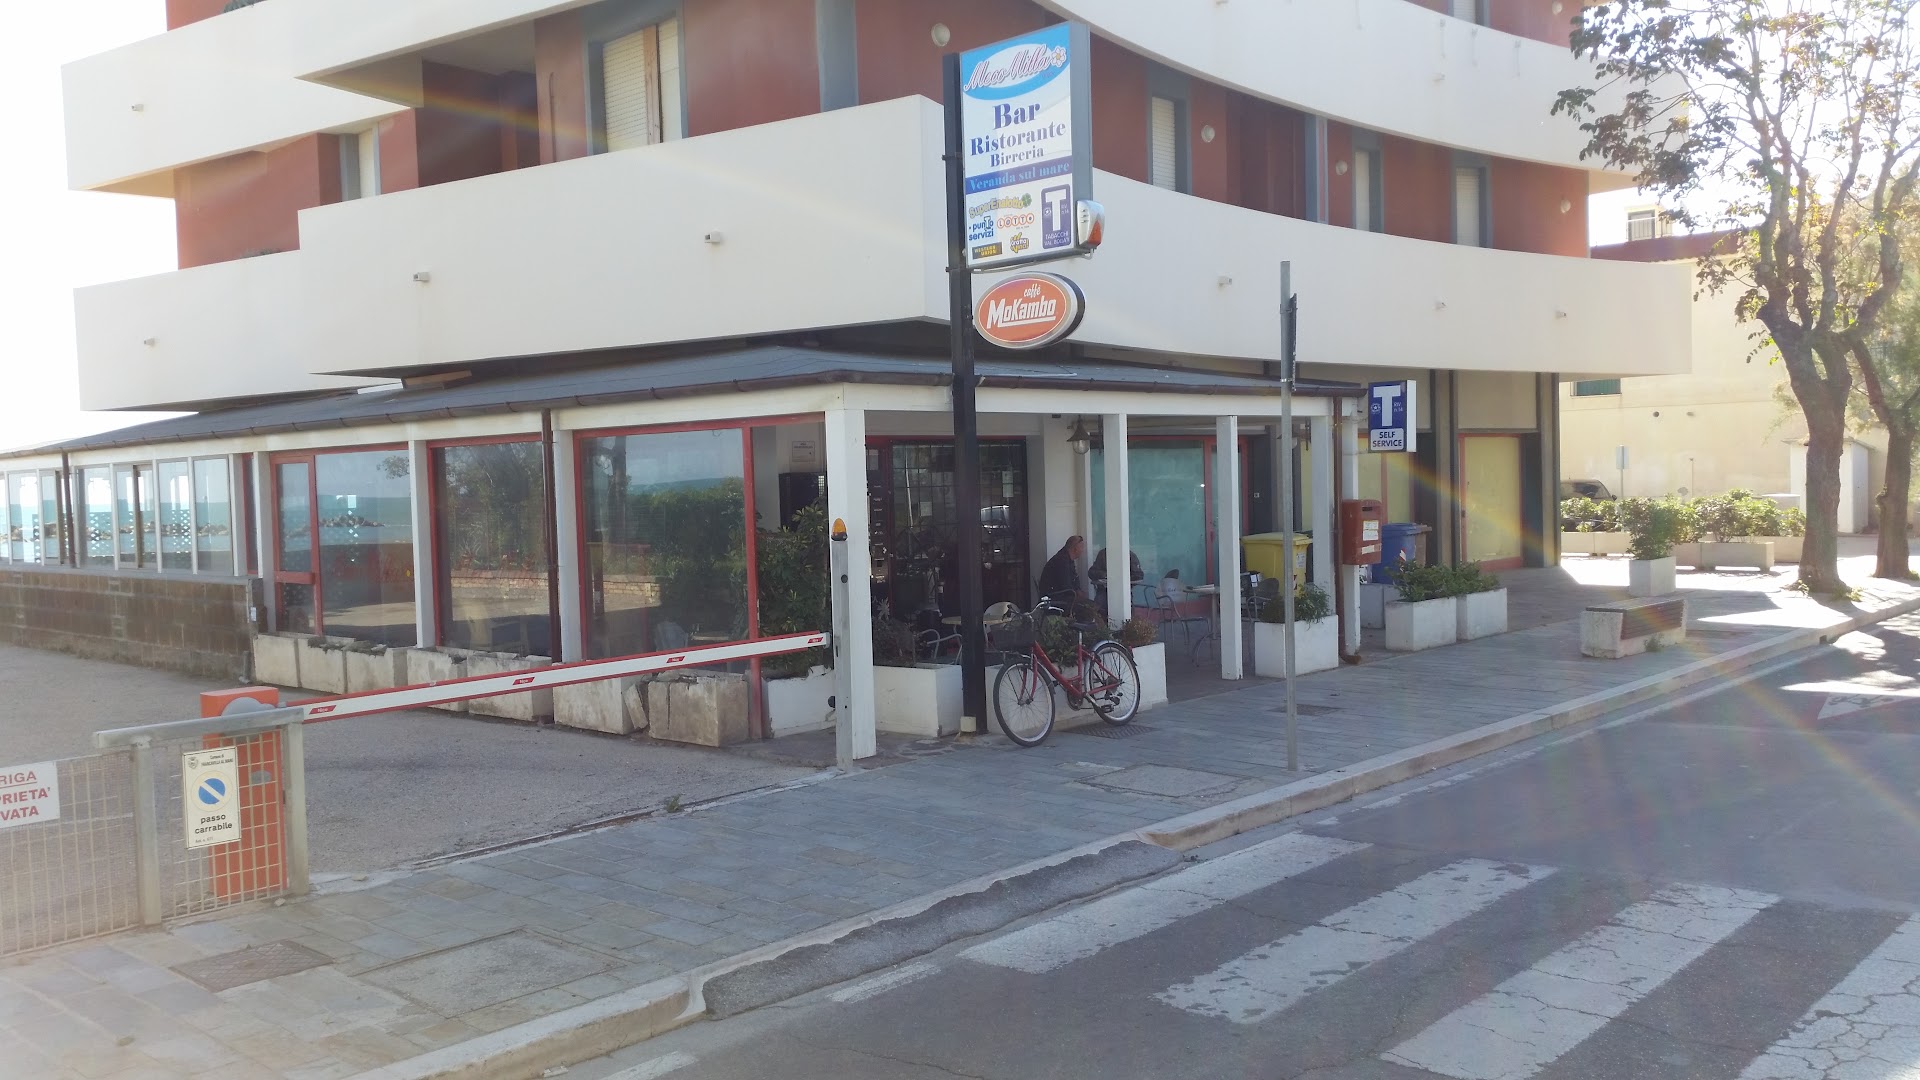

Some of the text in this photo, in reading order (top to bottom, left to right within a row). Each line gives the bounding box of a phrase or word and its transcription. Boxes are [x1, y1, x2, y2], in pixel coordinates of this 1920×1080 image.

[992, 103, 1040, 130] Bar
[970, 121, 1066, 156] Ristorante
[990, 145, 1044, 167] Birreria
[969, 162, 1070, 190] Veranda sul mare
[969, 228, 994, 241] servizi
[1379, 431, 1396, 439] SELF
[1372, 439, 1402, 447] SERVICE
[201, 814, 226, 824] passo
[195, 822, 232, 834] carrabile
